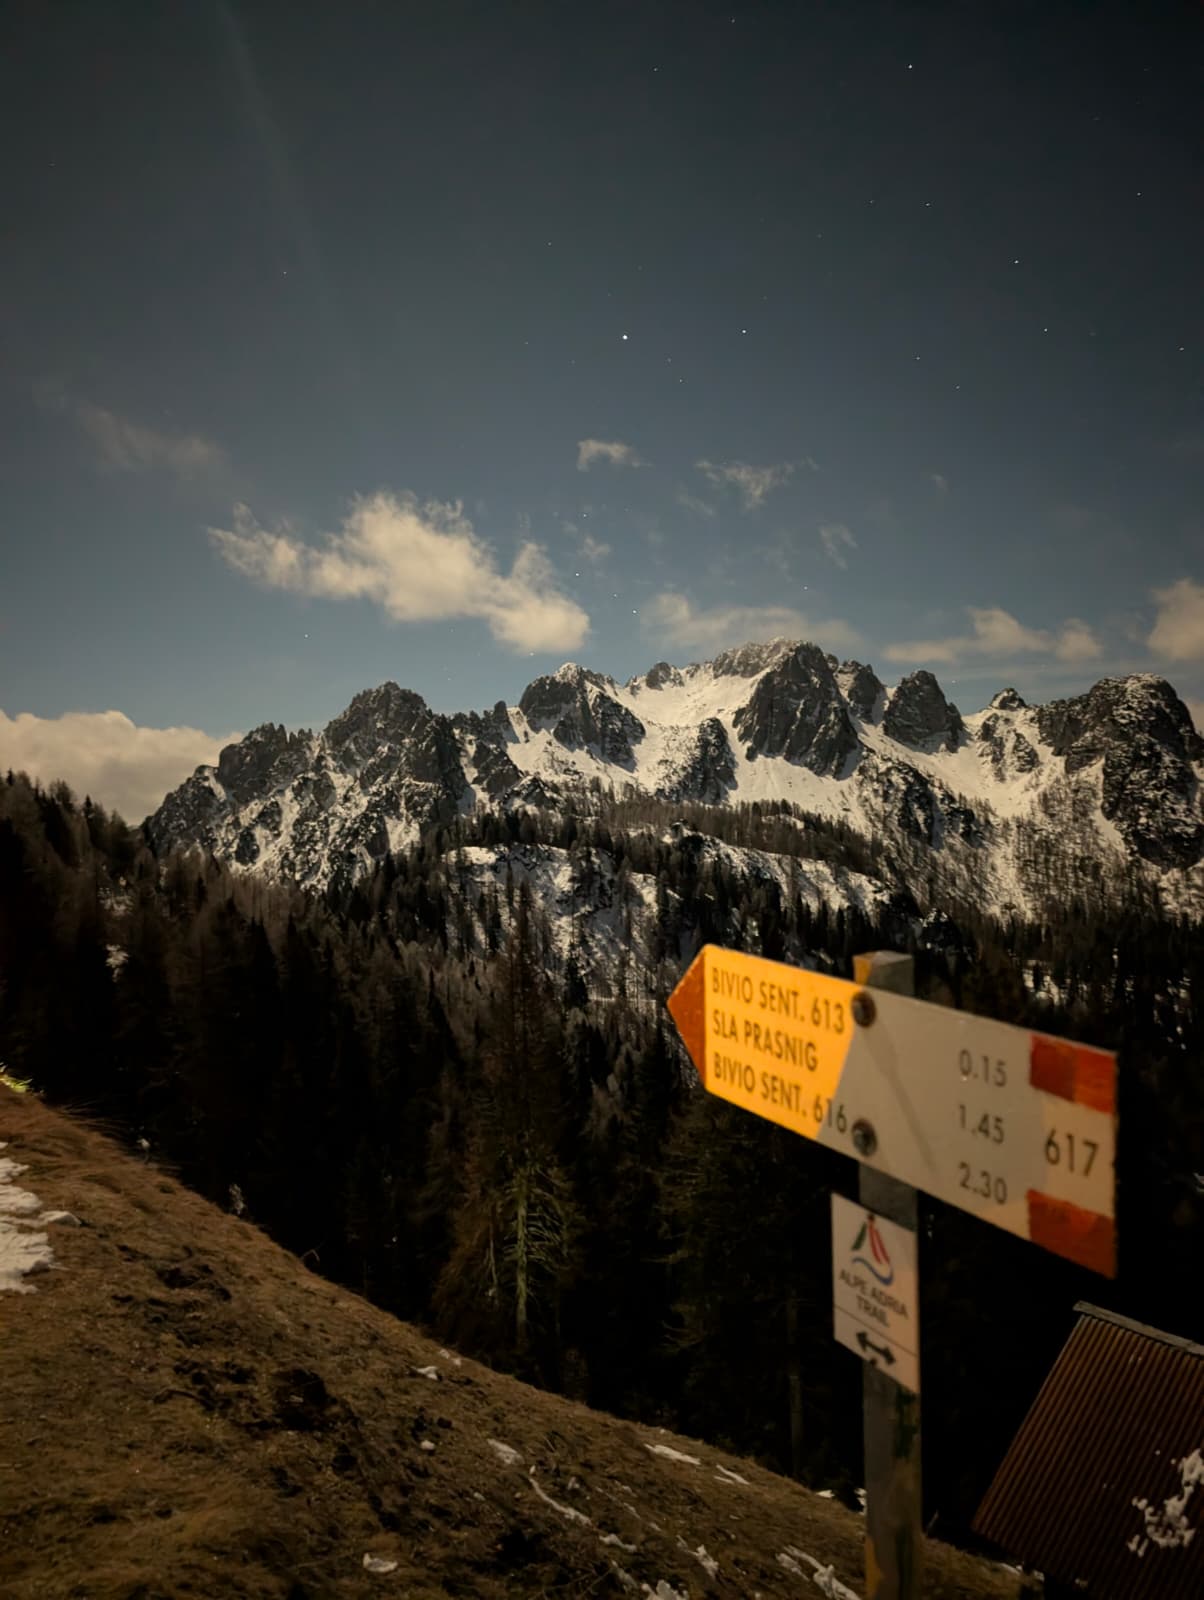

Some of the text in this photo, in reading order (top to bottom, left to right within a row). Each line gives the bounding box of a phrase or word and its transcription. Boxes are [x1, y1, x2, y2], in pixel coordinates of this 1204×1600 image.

[712, 967, 845, 1035] BIVIO SENT. 613
[712, 1009, 818, 1072] SLA PRASNIG
[959, 1049, 1007, 1087] 0.15
[714, 1052, 847, 1133] BIVIO SENT. 616
[959, 1104, 1005, 1144] 1.45
[1044, 1128, 1098, 1177] 617
[958, 1161, 1008, 1205] 2.30
[856, 1293, 890, 1328] TRAIL
